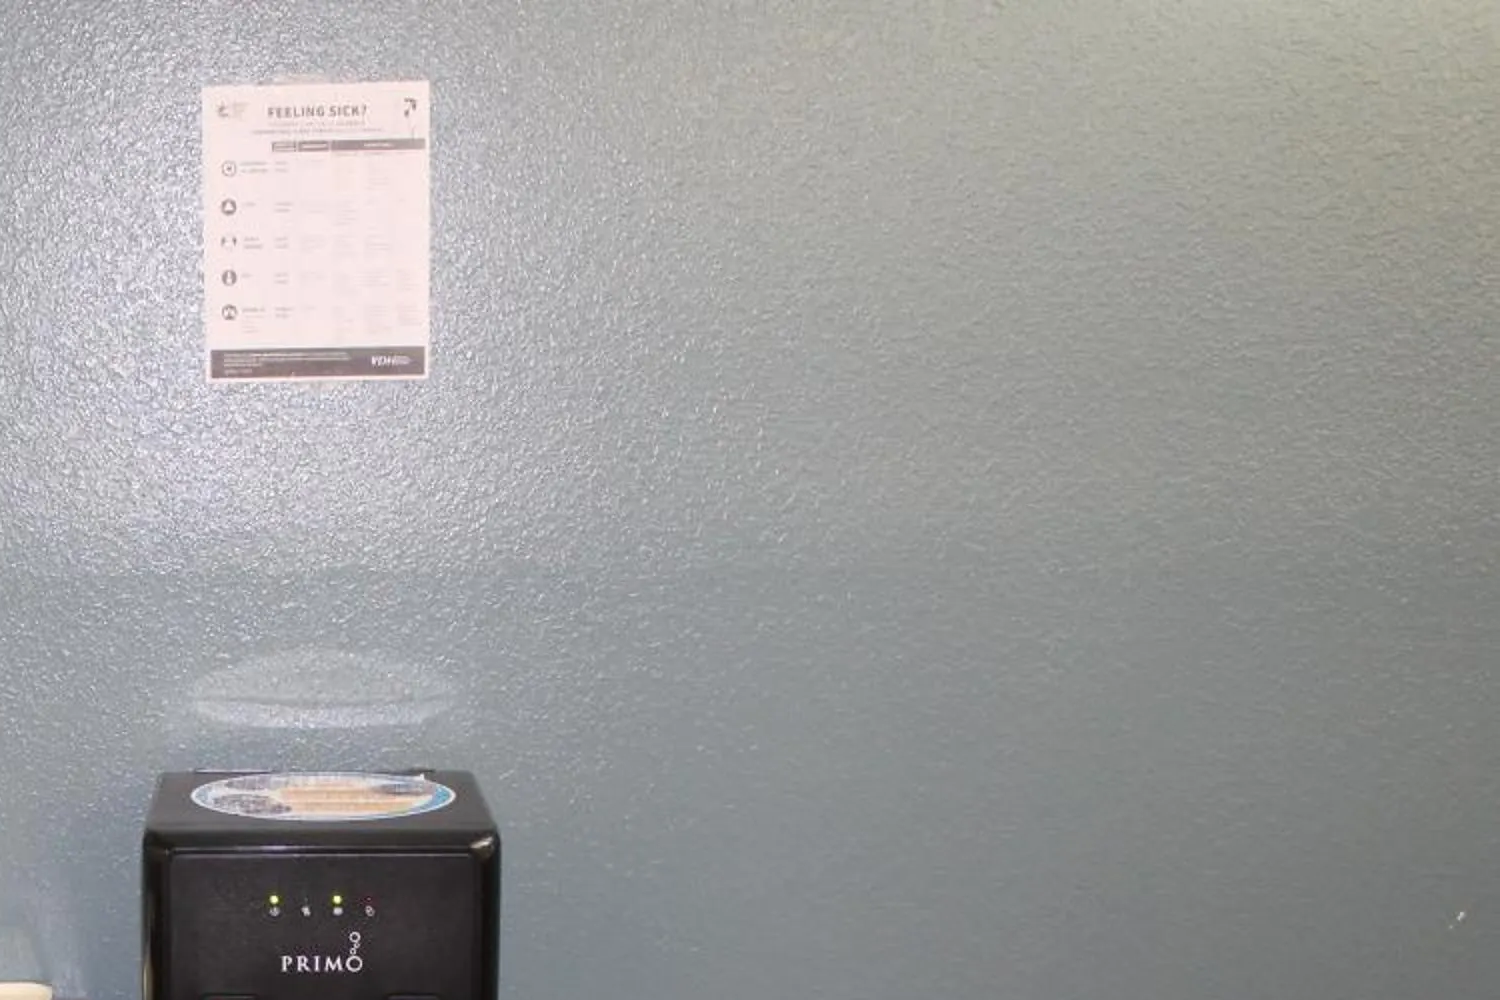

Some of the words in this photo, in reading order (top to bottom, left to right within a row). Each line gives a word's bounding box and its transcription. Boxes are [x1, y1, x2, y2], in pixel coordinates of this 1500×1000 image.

[267, 104, 326, 119] FEELING
[328, 103, 368, 118] SICK?
[280, 955, 363, 973] PRIMO
